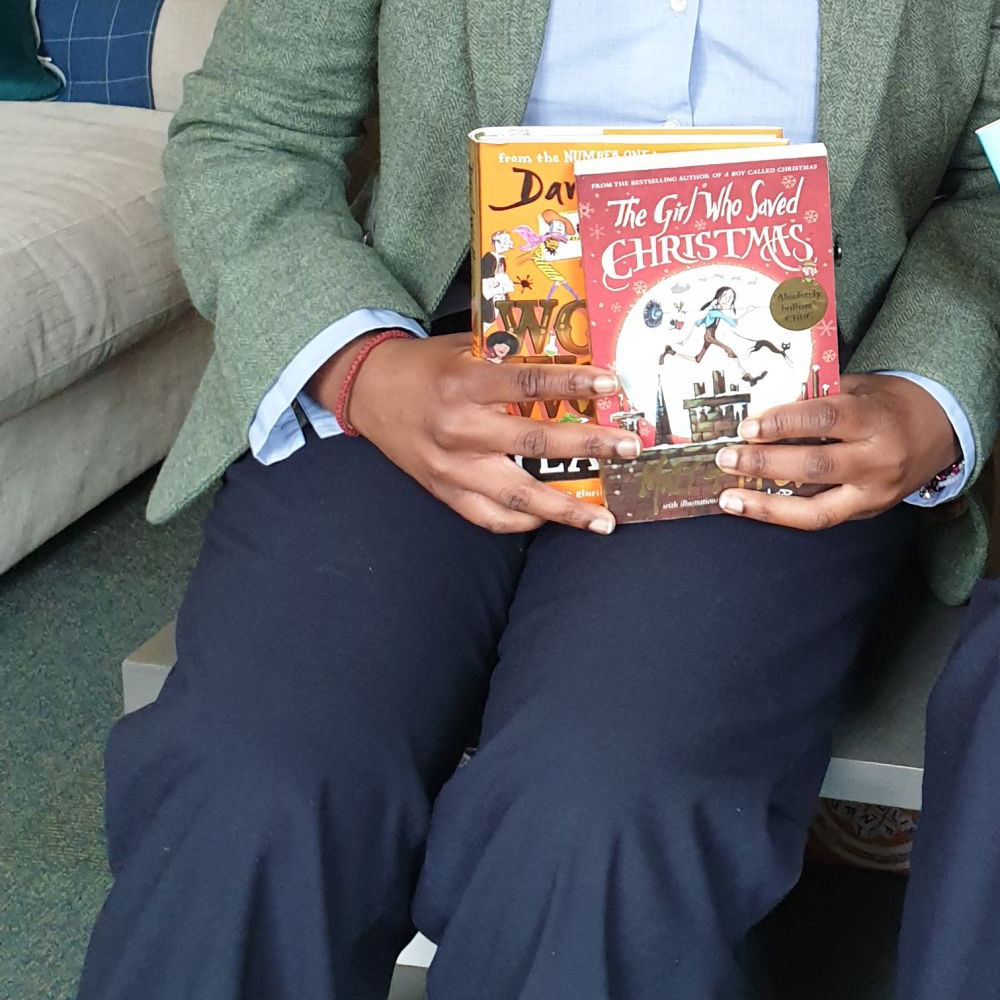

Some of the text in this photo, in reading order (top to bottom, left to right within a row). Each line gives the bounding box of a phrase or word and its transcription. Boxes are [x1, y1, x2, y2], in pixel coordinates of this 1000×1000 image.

[498, 151, 532, 164] from
[536, 151, 559, 164] the
[591, 182, 613, 190] FROM
[614, 180, 629, 188] THE
[631, 176, 678, 187] BESTSELLING
[679, 173, 710, 182] AUTHOR
[712, 171, 722, 179] OF
[731, 169, 747, 178] BOY
[747, 167, 776, 176] CALLED
[776, 163, 818, 173] CHRISTMAS
[607, 176, 805, 238] The Girl Who Saved
[601, 222, 818, 292] CHRISTMAS
[662, 500, 679, 510] with
